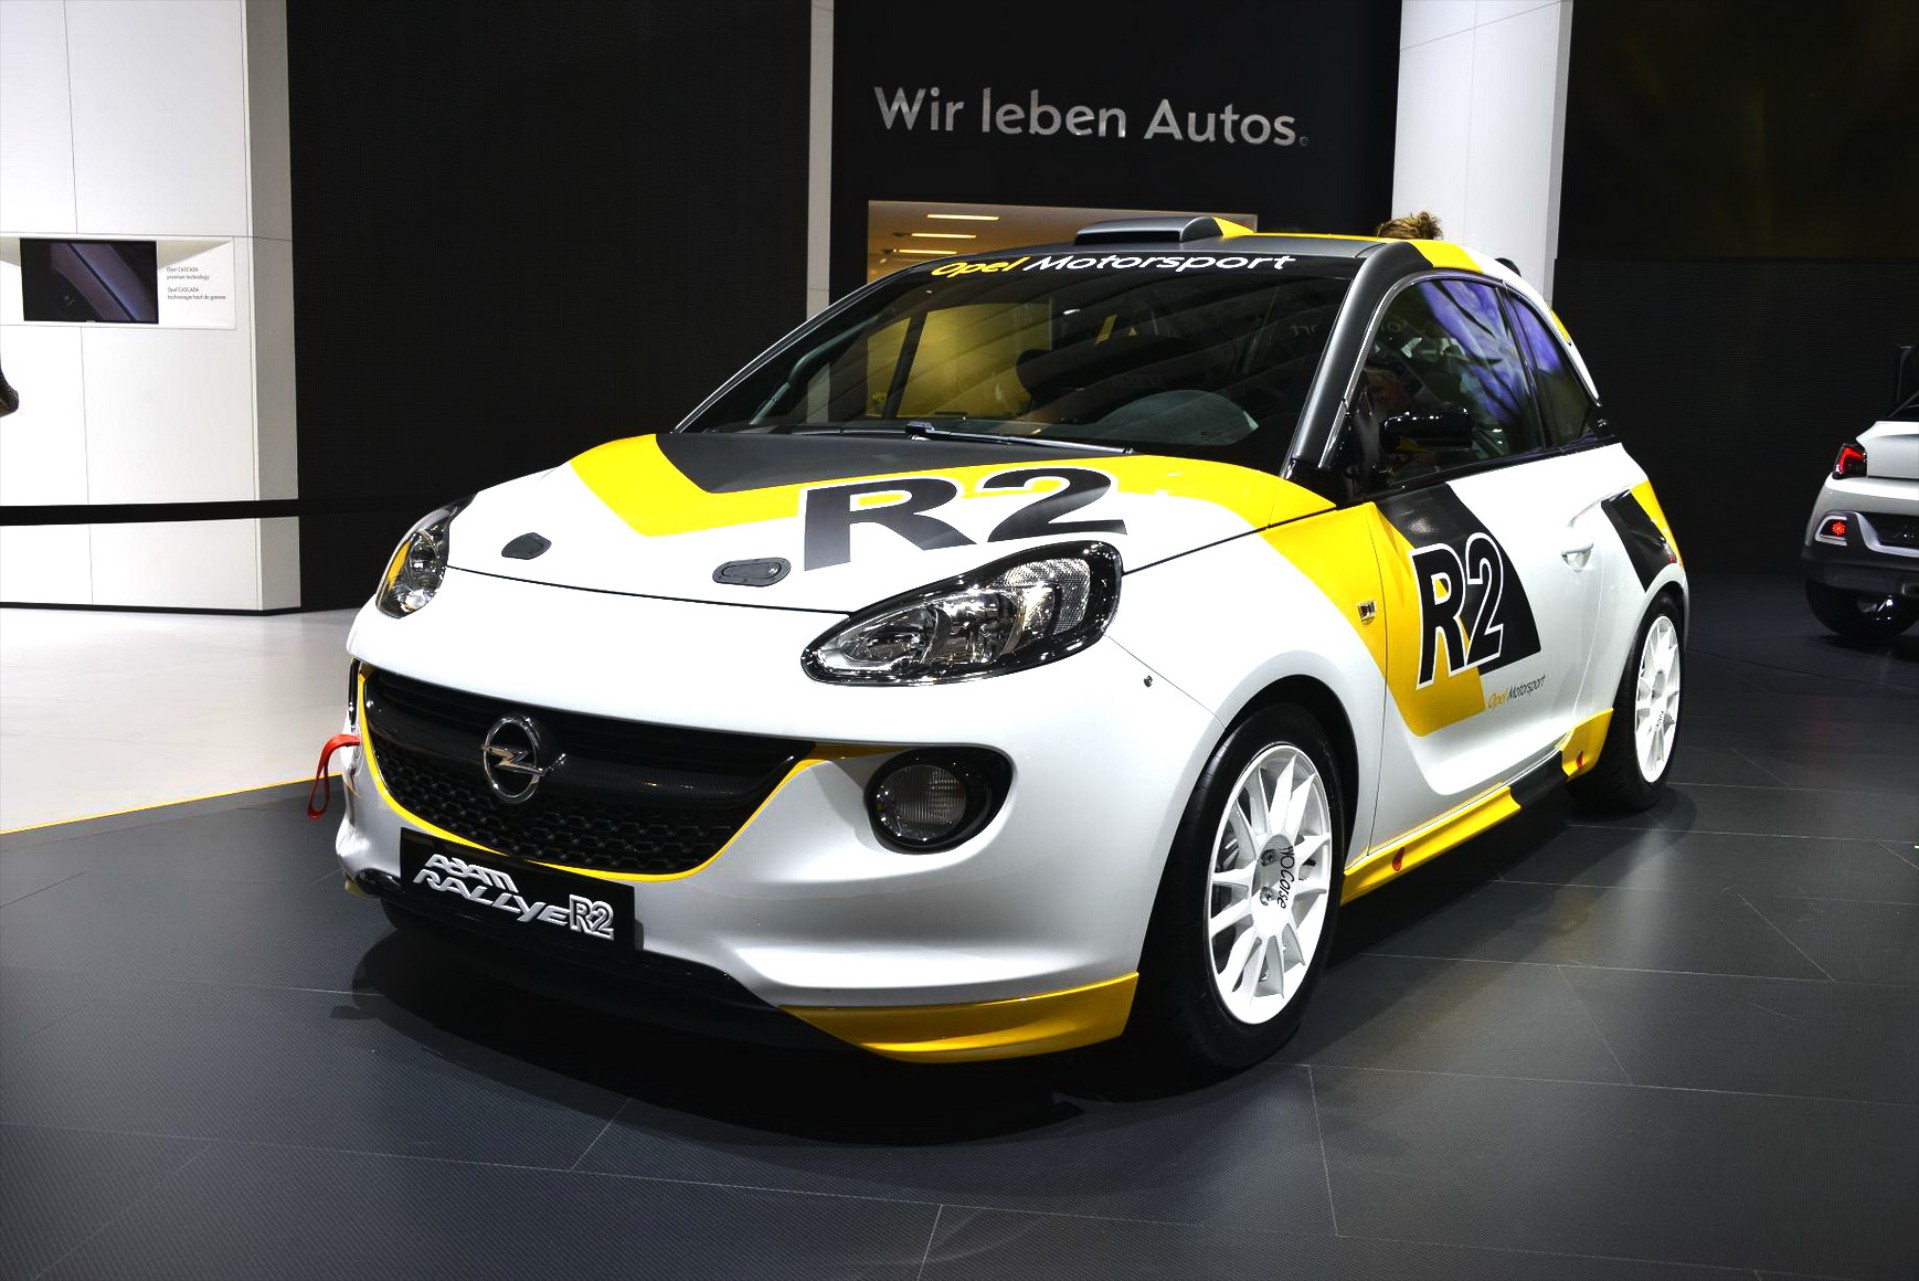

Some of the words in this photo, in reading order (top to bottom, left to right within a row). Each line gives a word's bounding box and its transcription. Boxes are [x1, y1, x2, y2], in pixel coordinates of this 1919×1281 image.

[874, 86, 964, 132] Wir
[981, 87, 1126, 138] leben
[931, 256, 1030, 277] Opel
[1024, 254, 1297, 272] Motorsport
[803, 467, 1128, 572] R2
[1408, 532, 1505, 690] R2
[569, 894, 615, 941] R2
